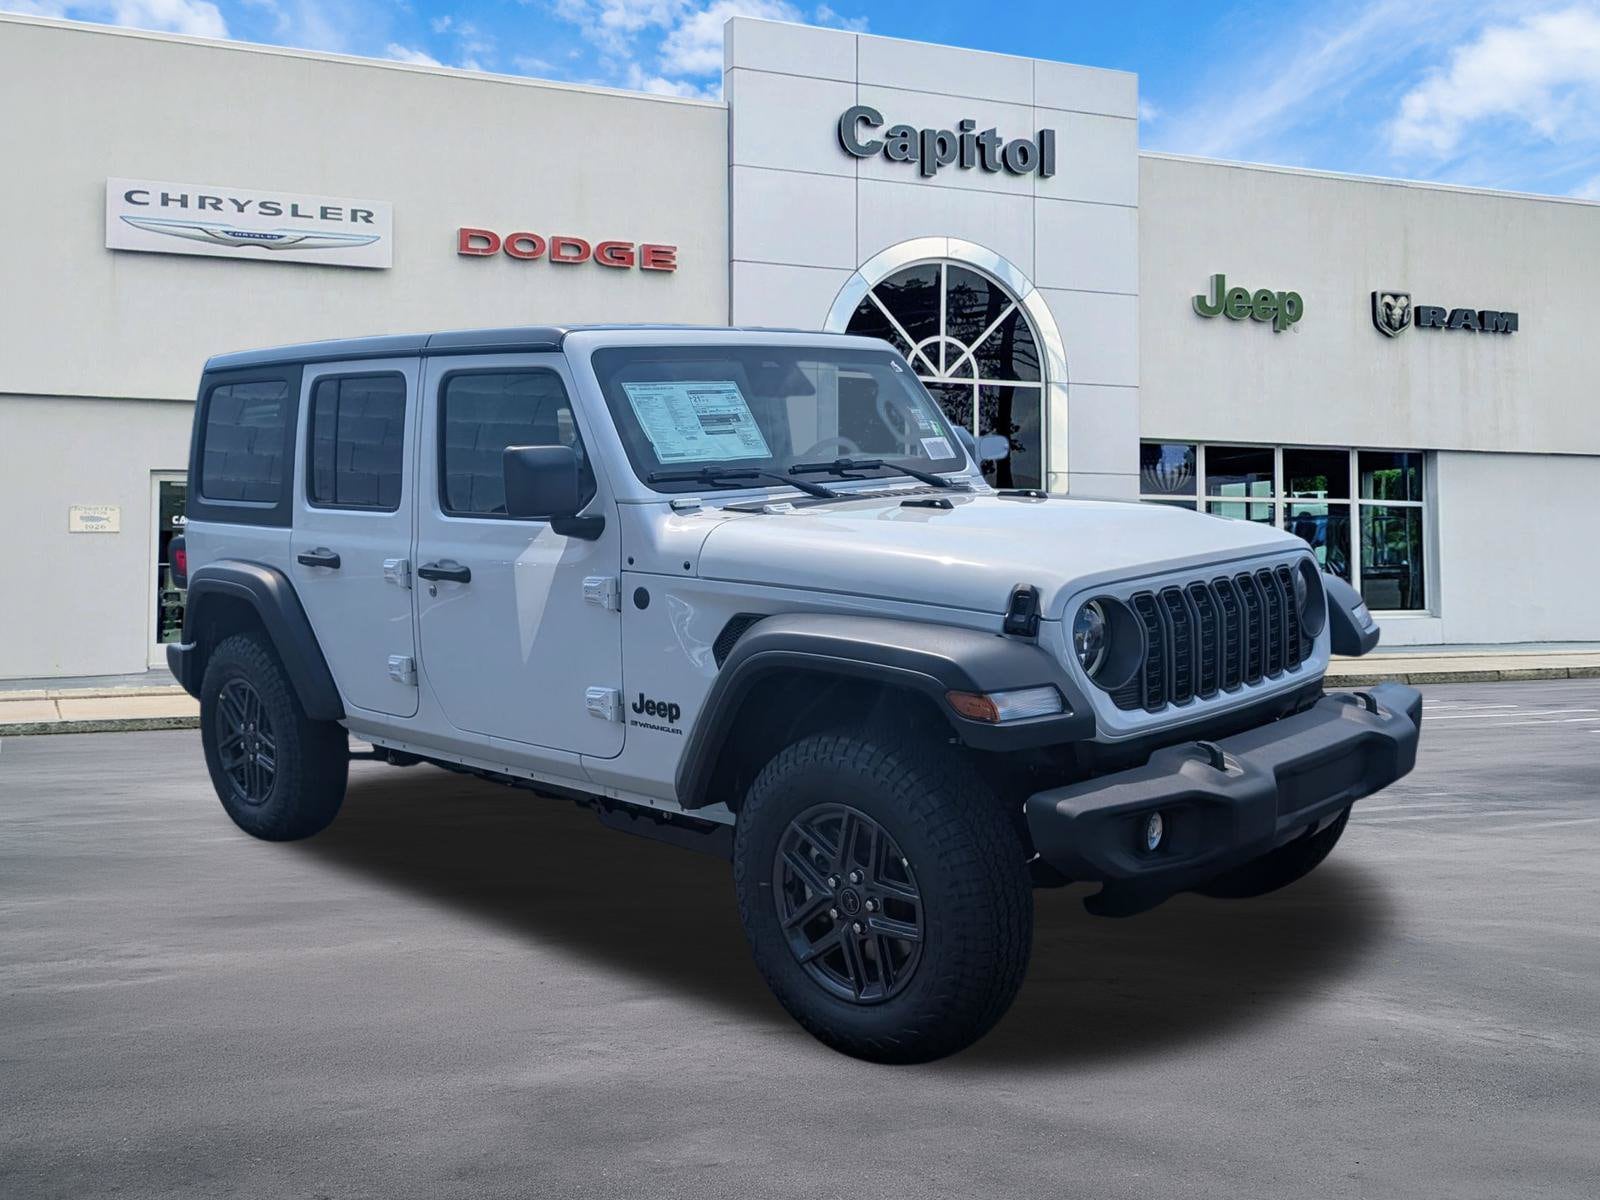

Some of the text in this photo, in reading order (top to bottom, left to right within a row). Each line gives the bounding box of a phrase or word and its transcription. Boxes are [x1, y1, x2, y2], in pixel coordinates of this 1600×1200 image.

[837, 105, 1056, 178] Capitol
[124, 189, 375, 224] CHRYSLER
[457, 227, 678, 272] DODGE
[1192, 273, 1304, 333] Jeep
[1414, 305, 1519, 333] RAM
[632, 692, 681, 723] Jeep
[638, 721, 683, 736] WRANGLER
